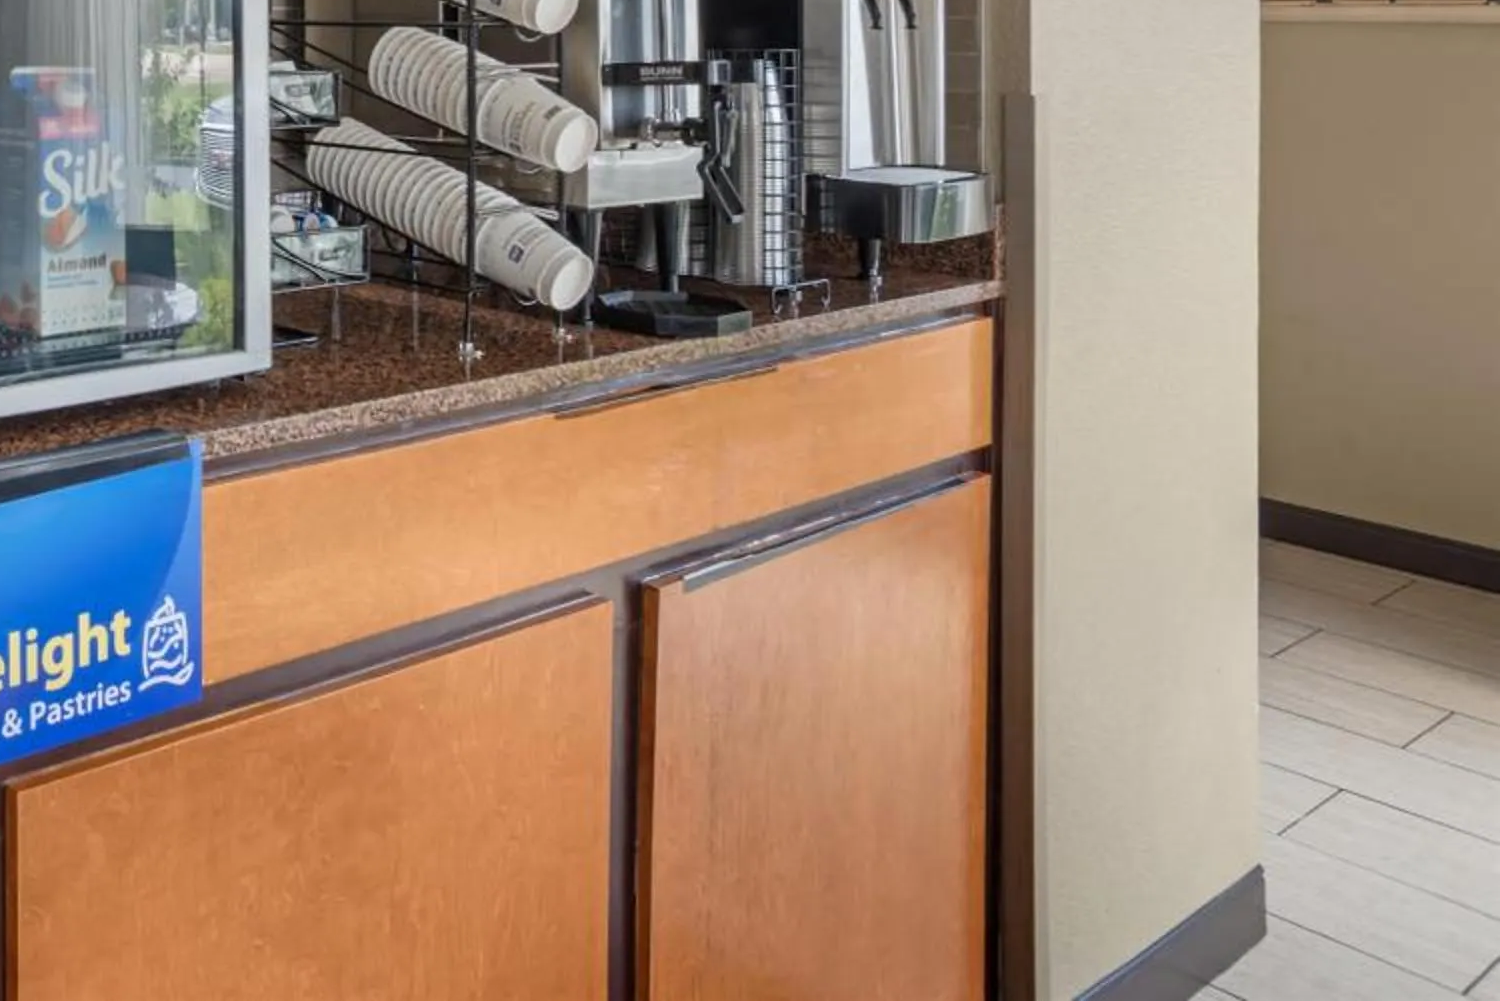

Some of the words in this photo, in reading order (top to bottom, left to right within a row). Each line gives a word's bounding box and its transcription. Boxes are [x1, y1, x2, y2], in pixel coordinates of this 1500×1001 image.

[38, 141, 126, 219] Silk
[47, 251, 107, 273] Almond
[1, 709, 23, 737] &
[29, 680, 132, 732] Pastries
